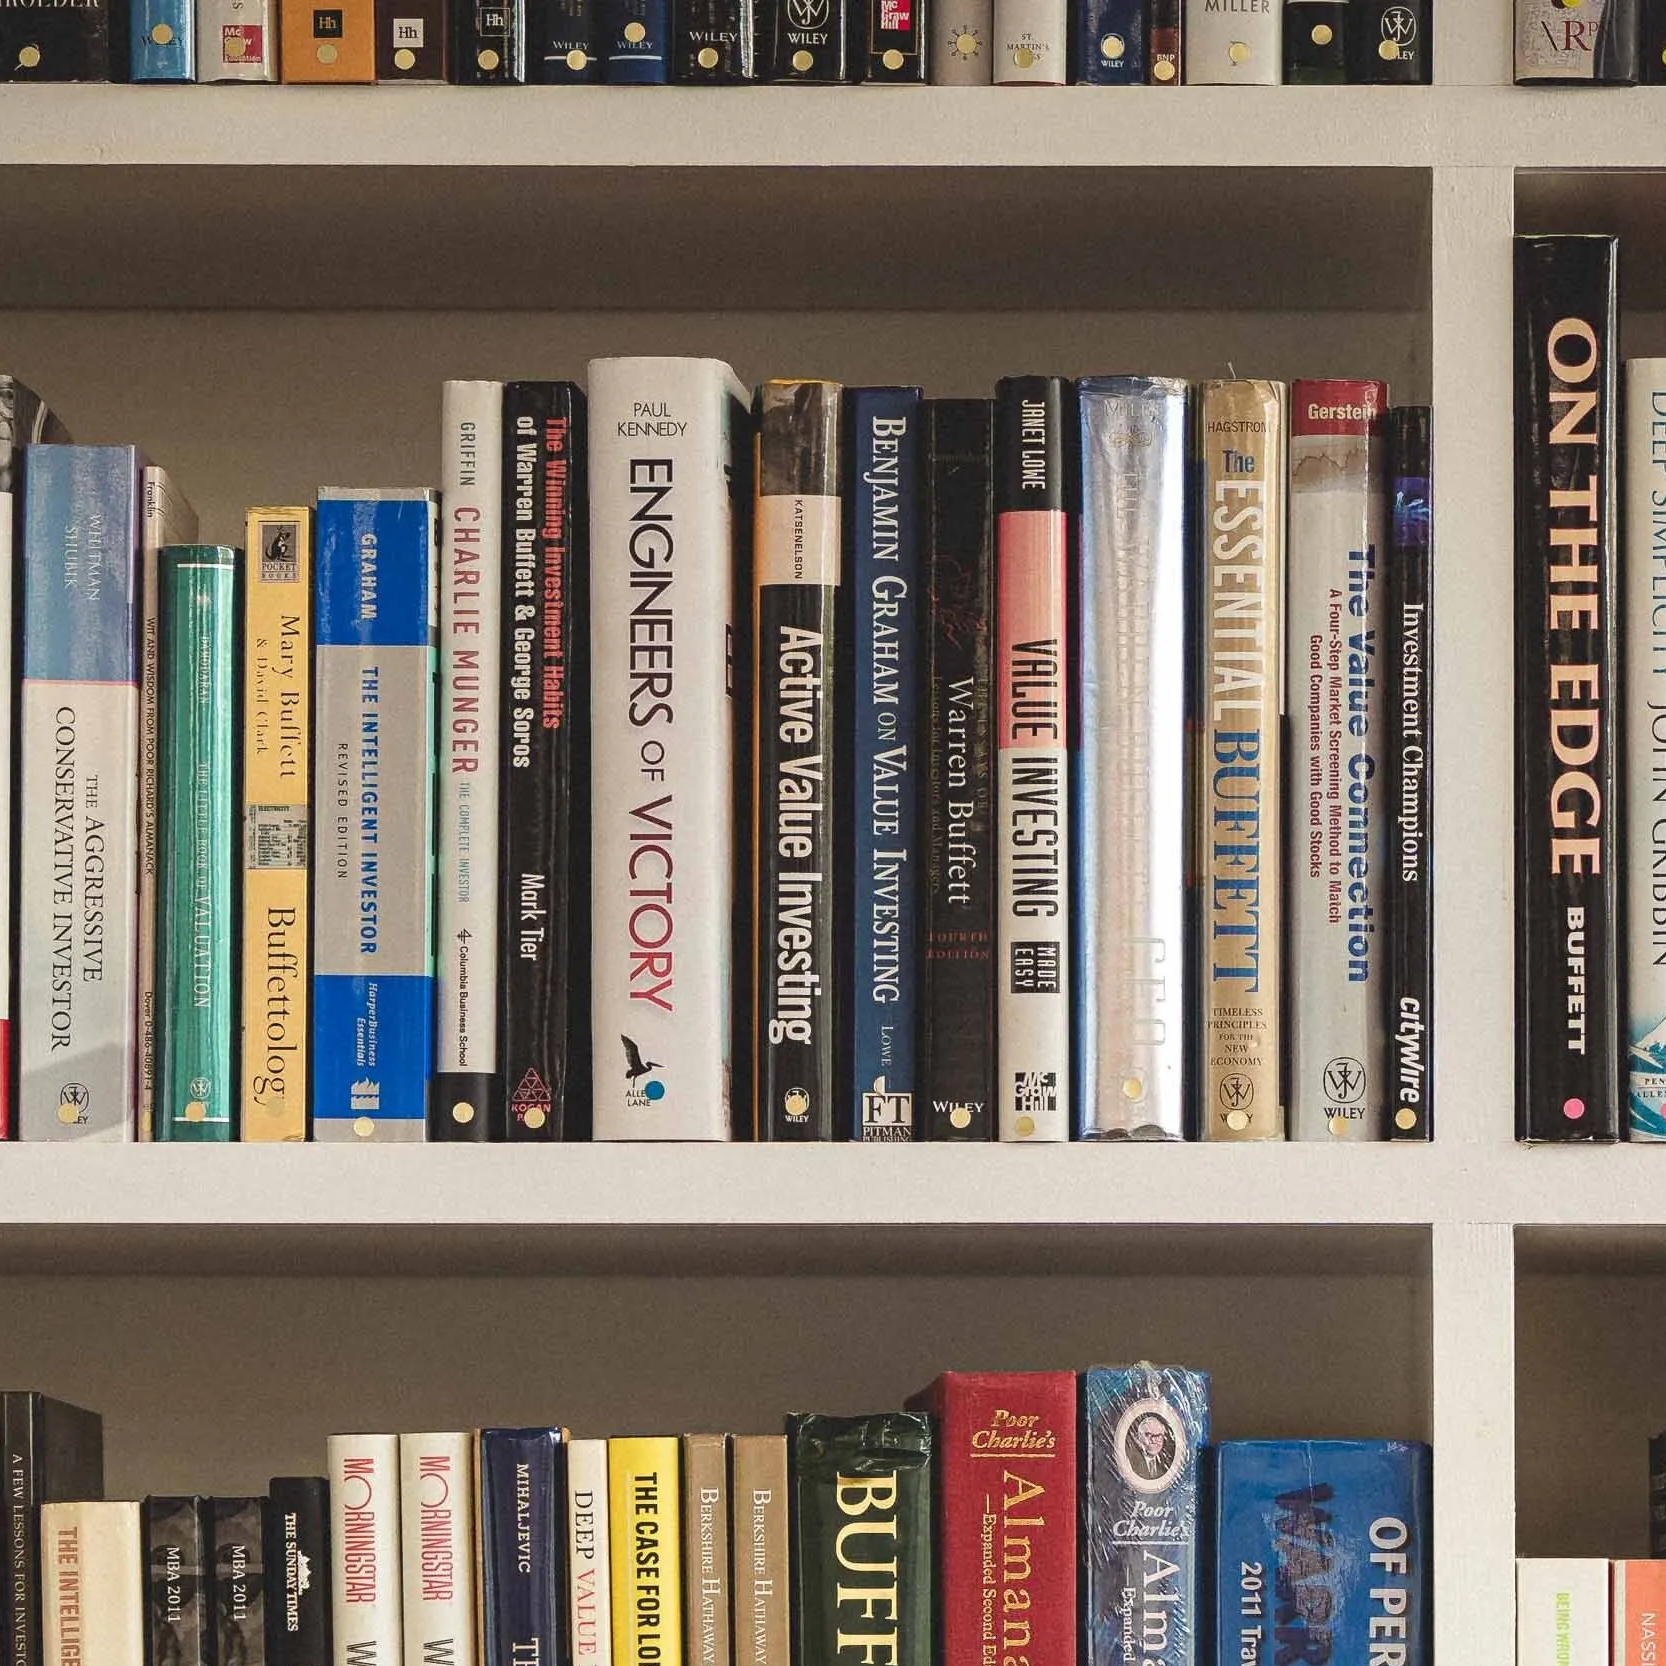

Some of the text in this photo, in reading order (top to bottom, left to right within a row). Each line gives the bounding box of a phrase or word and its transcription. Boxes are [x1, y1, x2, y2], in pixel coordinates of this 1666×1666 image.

[1205, 0, 1270, 14] MILLER
[689, 32, 738, 42] WILEY
[787, 32, 828, 45] WILEY
[1101, 60, 1124, 68] WILEY
[634, 402, 671, 417] PAUL
[617, 422, 687, 437] KENNEDY
[1546, 317, 1602, 1056] ON THE EDGE BUFFETT
[629, 459, 673, 1011] ENGINEERS OF VICTORY
[1398, 603, 1424, 882] Investment Champions
[768, 623, 821, 1045] Active Value Investing
[1324, 1107, 1367, 1121] WILEY
[991, 1410, 1039, 1427] Poor
[972, 1430, 1055, 1448] Charlie's
[517, 1464, 530, 1572] MIHALJEVIC
